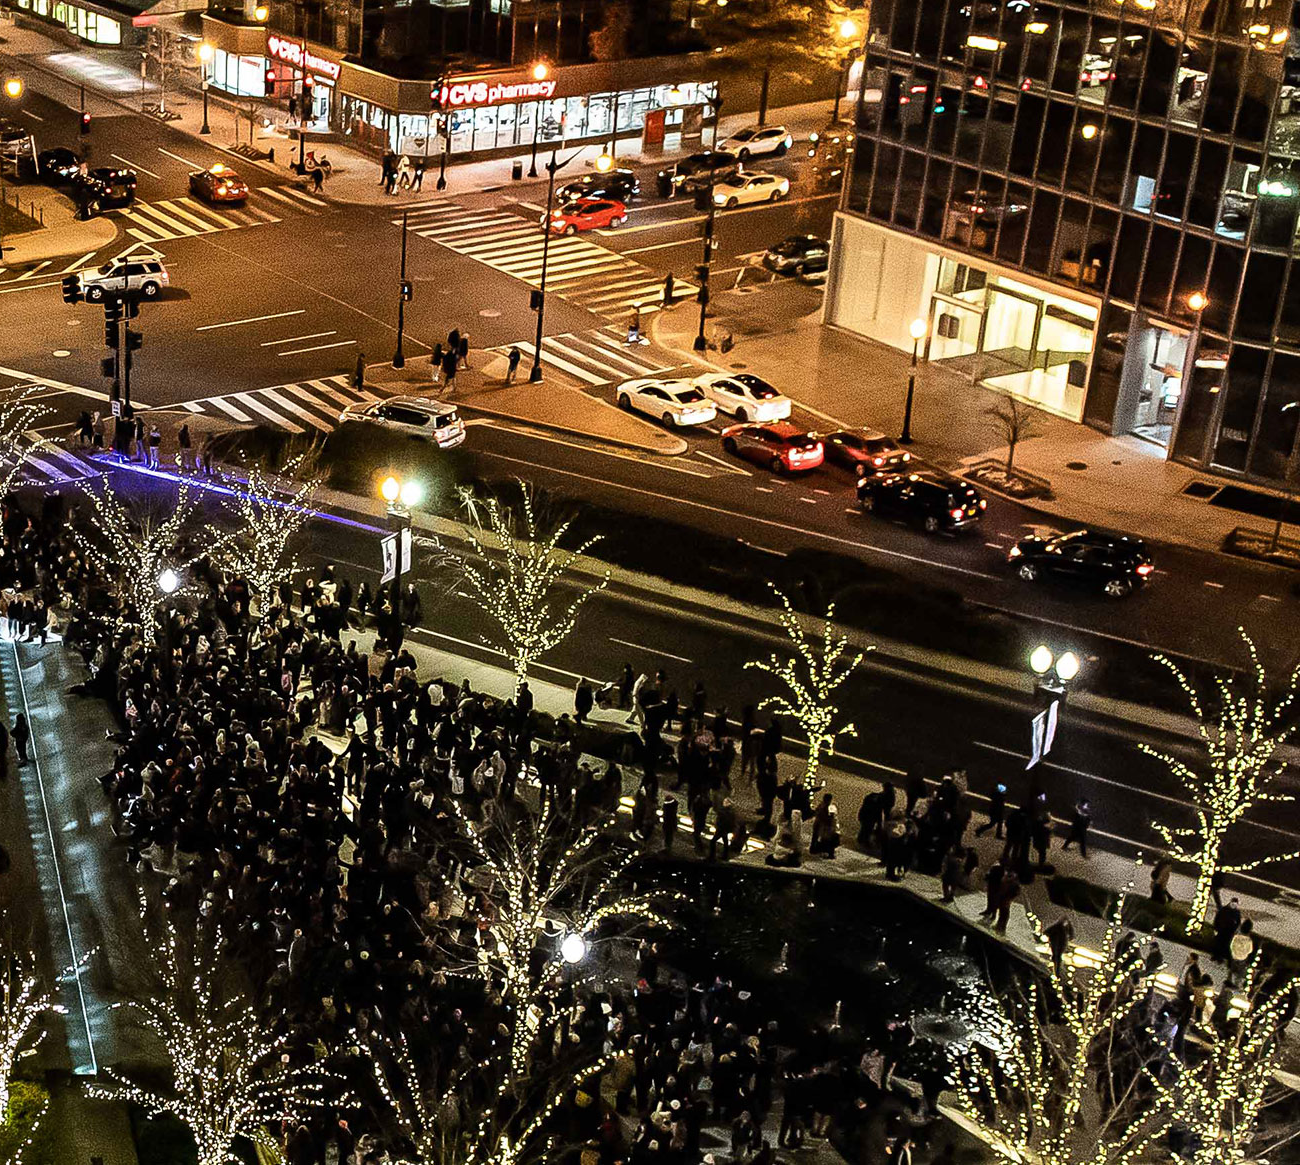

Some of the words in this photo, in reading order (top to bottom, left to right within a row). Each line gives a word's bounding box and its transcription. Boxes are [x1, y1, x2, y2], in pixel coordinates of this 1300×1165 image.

[279, 39, 300, 63] CVS
[449, 82, 489, 105] CVS
[488, 80, 556, 104] pharmacy
